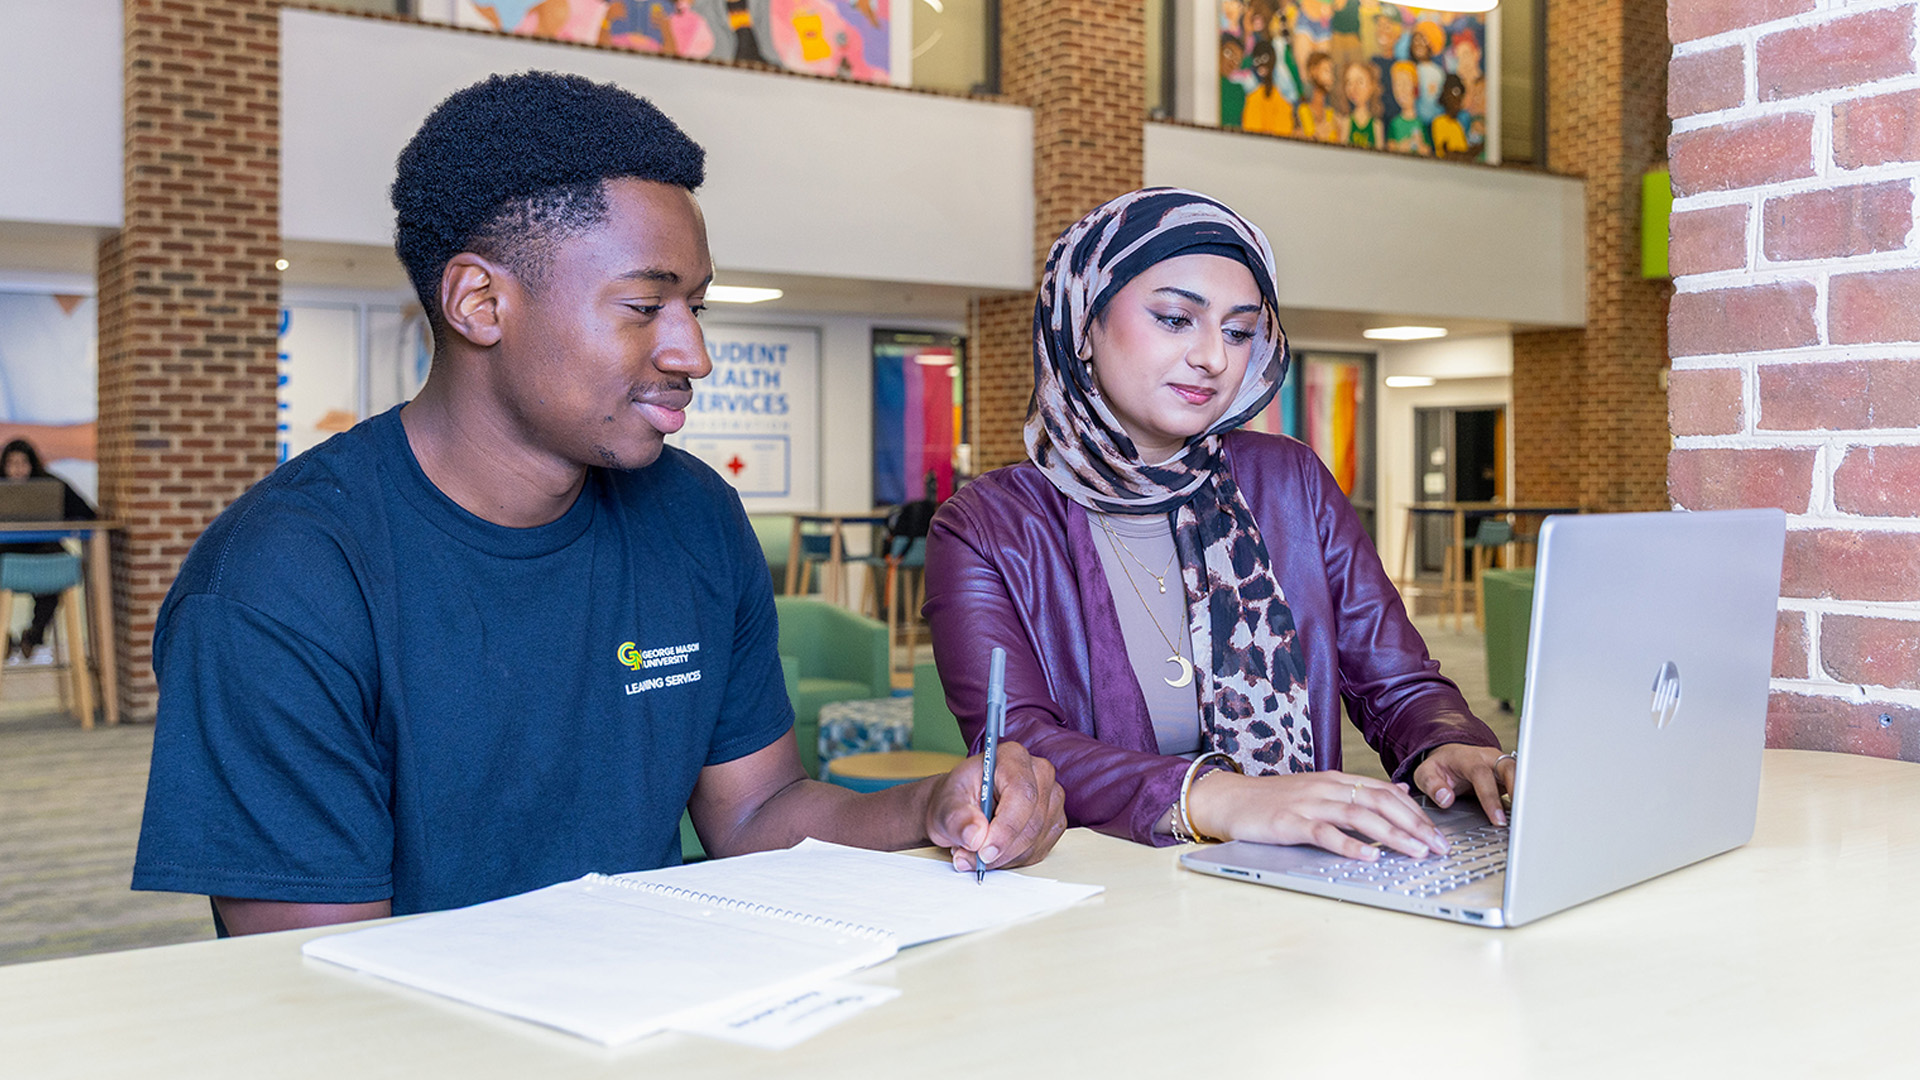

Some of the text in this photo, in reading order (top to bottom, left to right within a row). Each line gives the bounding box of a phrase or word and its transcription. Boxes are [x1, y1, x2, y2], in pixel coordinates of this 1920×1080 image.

[706, 342, 788, 365] UDENT
[642, 647, 675, 659] GEORGE
[643, 654, 688, 668] UNIVERSITY
[665, 670, 701, 686] SERVICES
[1651, 662, 1678, 730] hp
